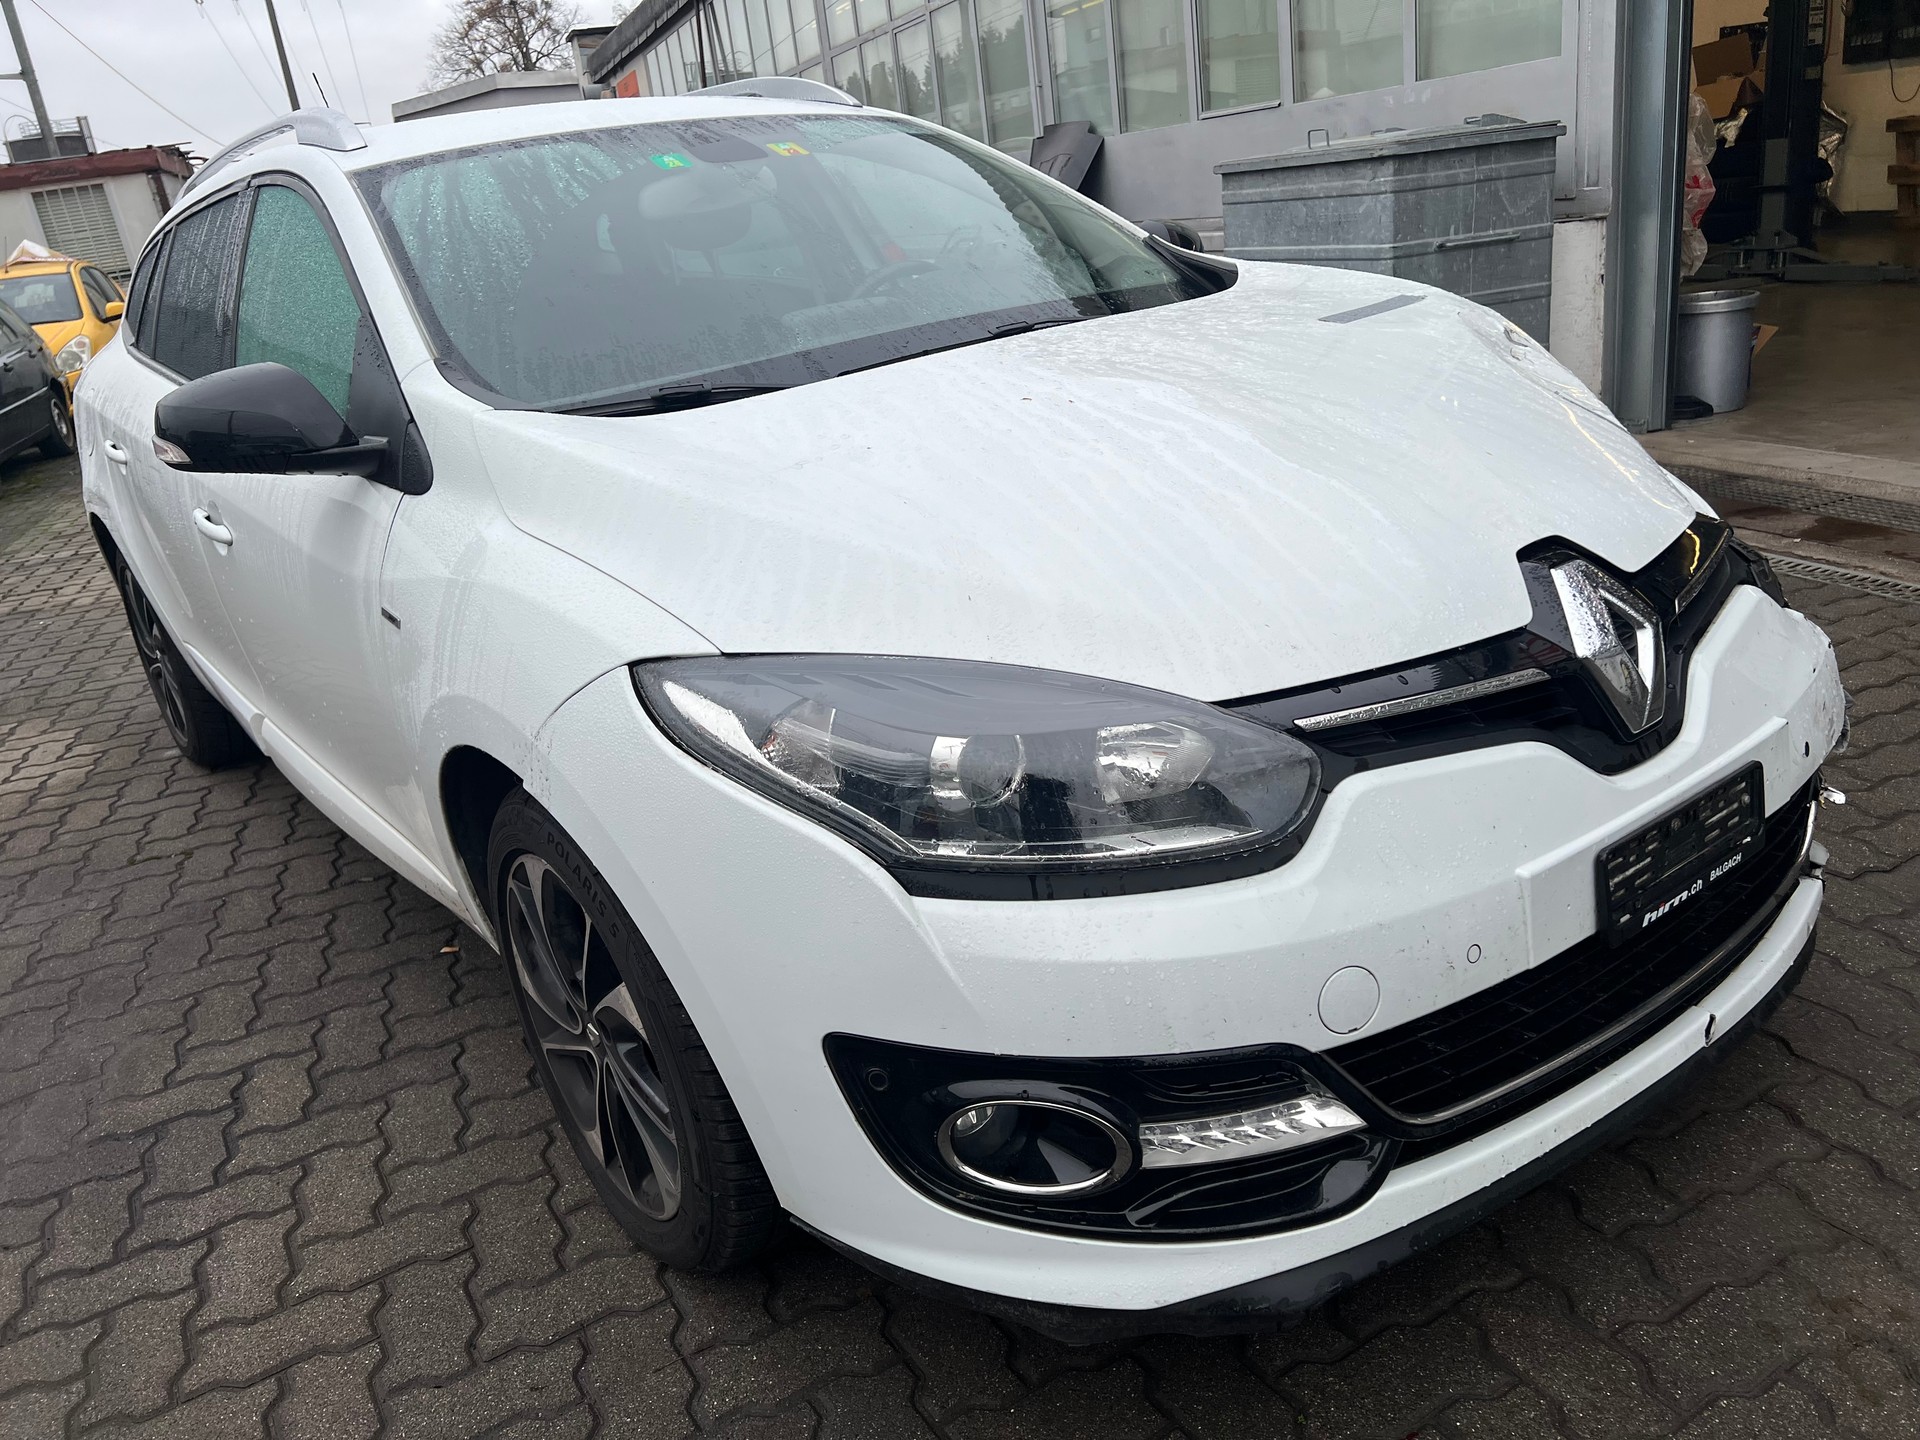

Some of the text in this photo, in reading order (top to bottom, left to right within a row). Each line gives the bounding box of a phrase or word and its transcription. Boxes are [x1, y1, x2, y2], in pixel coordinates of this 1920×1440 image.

[546, 831, 620, 939] POLARIS 5
[1641, 852, 1742, 928] hirn.ch BALGACH
